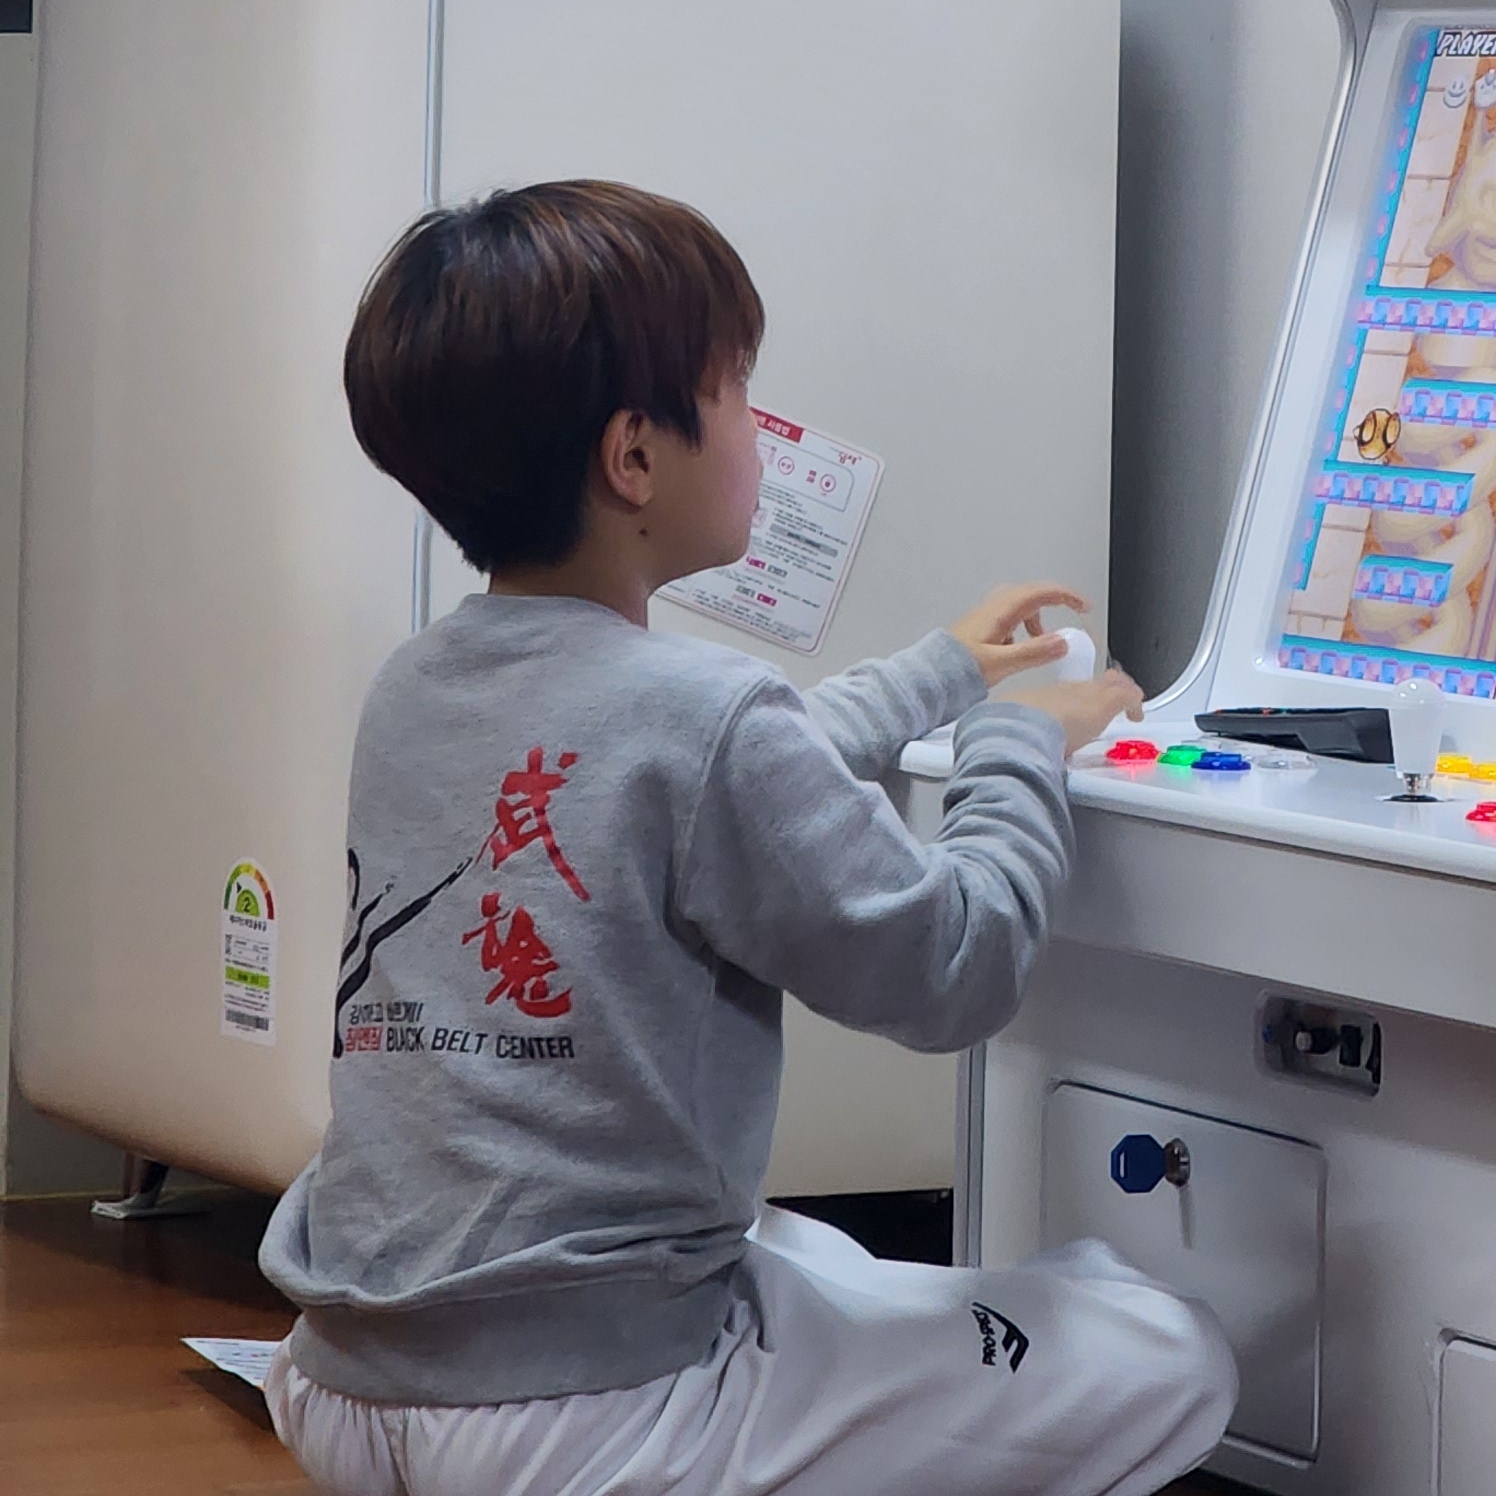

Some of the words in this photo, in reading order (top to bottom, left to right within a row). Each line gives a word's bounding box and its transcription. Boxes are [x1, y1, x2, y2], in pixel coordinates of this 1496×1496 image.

[386, 1026, 425, 1053] BLACK
[431, 1027, 488, 1055] BELT
[496, 1034, 575, 1060] CENTER
